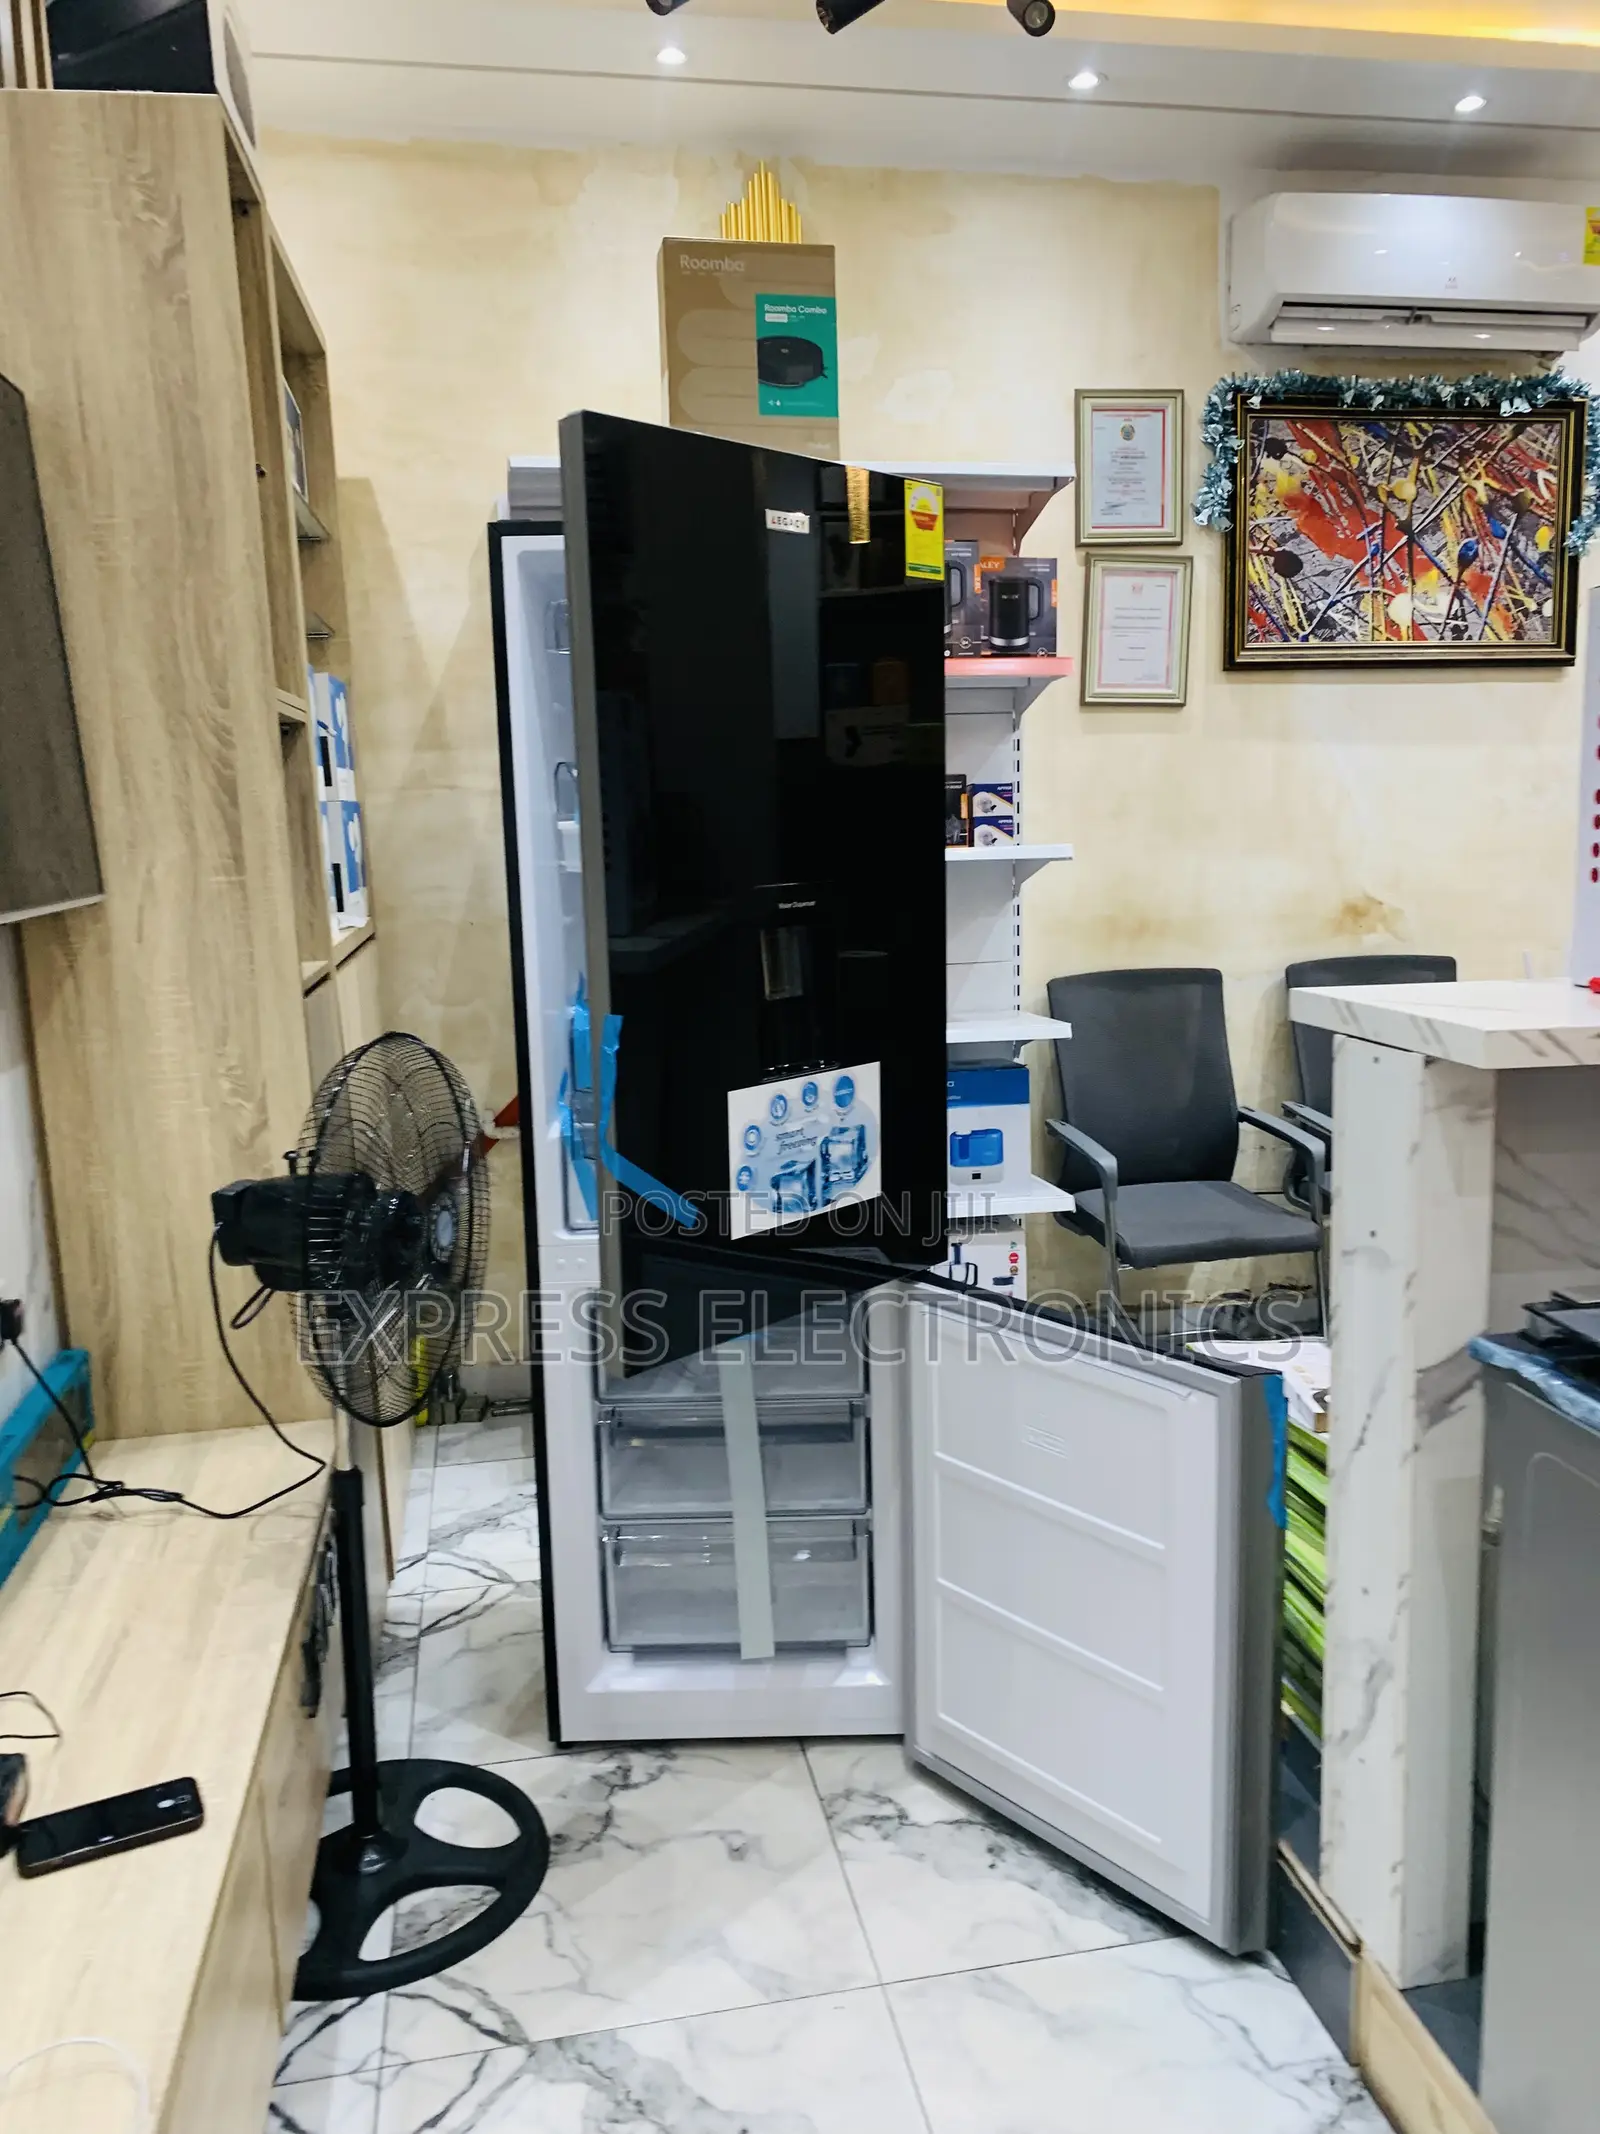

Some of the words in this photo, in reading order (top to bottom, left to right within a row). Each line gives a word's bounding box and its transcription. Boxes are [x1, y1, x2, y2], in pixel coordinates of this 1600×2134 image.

[680, 254, 746, 272] Roomba
[764, 303, 796, 313] Roomba
[798, 305, 828, 315] Combo
